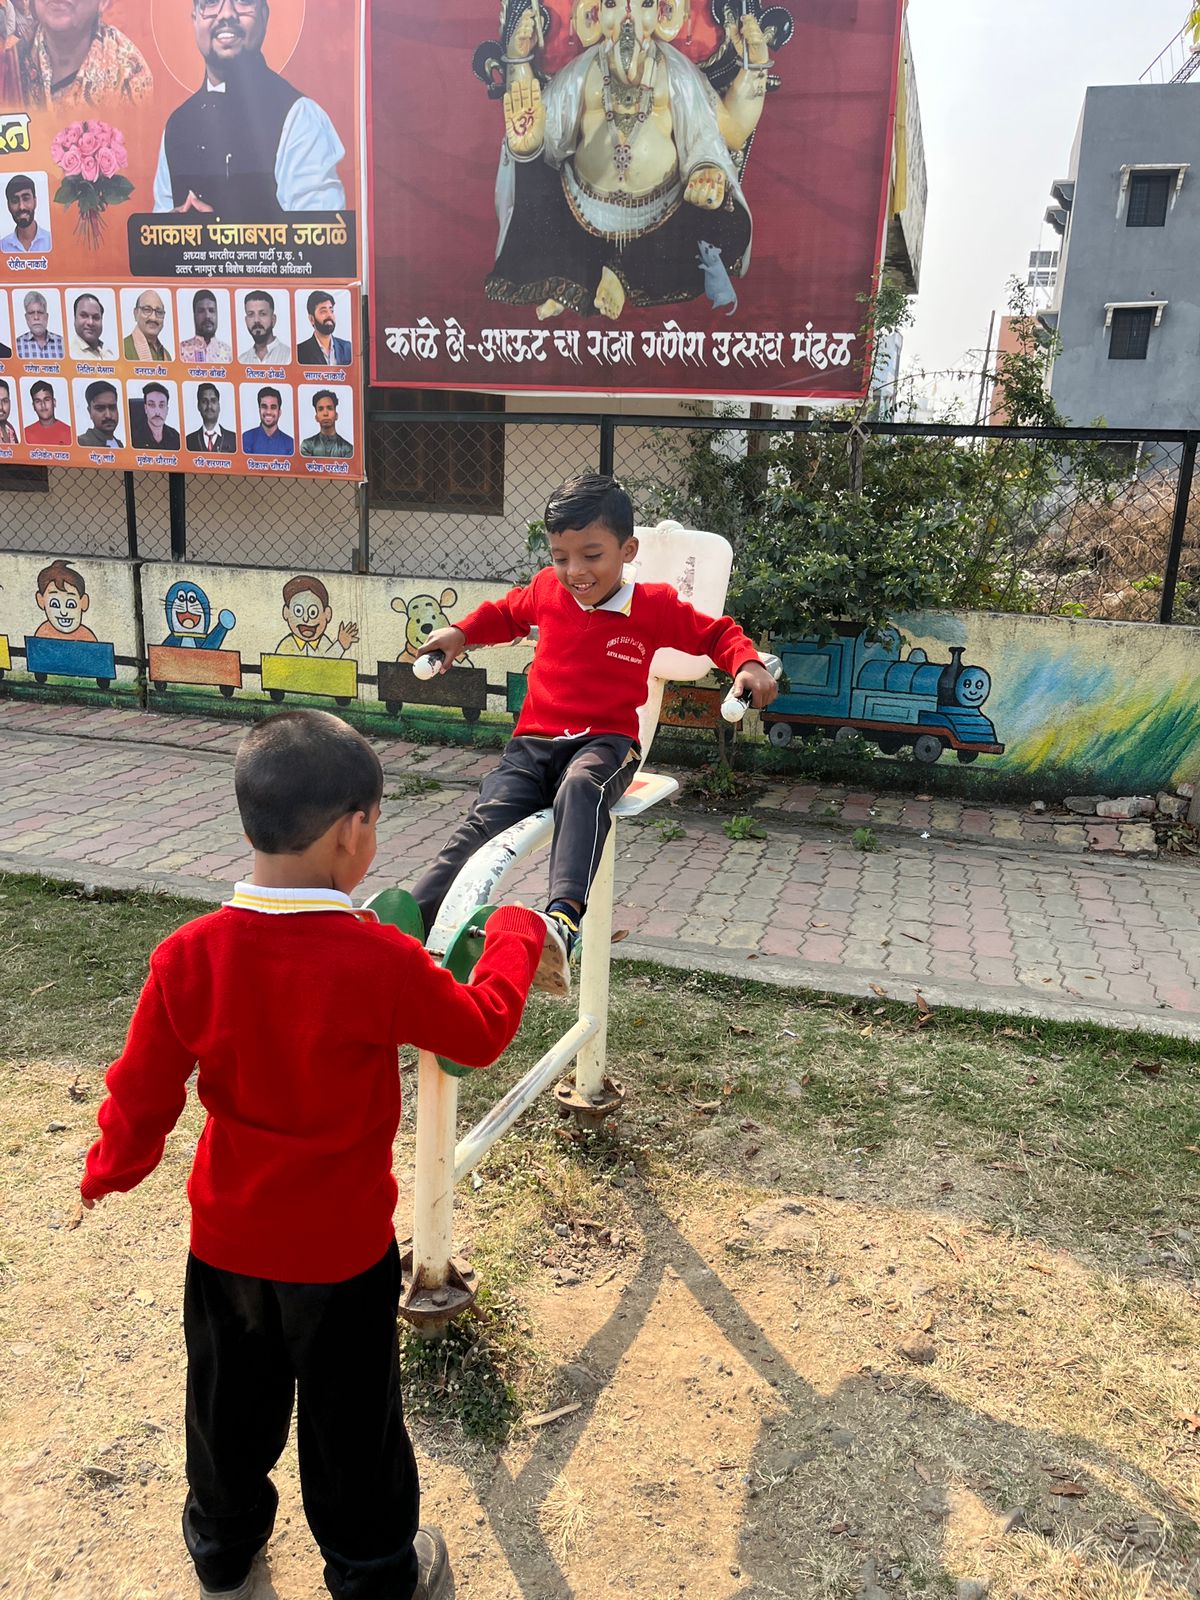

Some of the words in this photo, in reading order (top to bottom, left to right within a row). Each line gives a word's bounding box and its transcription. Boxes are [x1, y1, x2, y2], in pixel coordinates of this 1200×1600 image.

[140, 224, 202, 246] आकाश
[207, 217, 288, 246] पंजाबराव
[292, 213, 347, 246] जटाळे
[183, 251, 206, 260] अध्यक्ष
[209, 248, 235, 260] भारतीय
[237, 251, 257, 260] जनता
[259, 248, 275, 260] पार्टी
[175, 265, 192, 274] उत्तर
[194, 265, 216, 277] नागपुर
[218, 265, 223, 274] व
[225, 262, 244, 274] विशेष
[246, 262, 277, 274] कार्यकारी
[280, 262, 312, 274] अधिकारी
[385, 316, 440, 362] काळे
[553, 330, 583, 365] चा
[587, 331, 636, 366] राजा
[641, 320, 707, 367] गणेश
[712, 332, 785, 368] उत्सव
[790, 321, 856, 370] मंडळ
[305, 372, 321, 380] सागर
